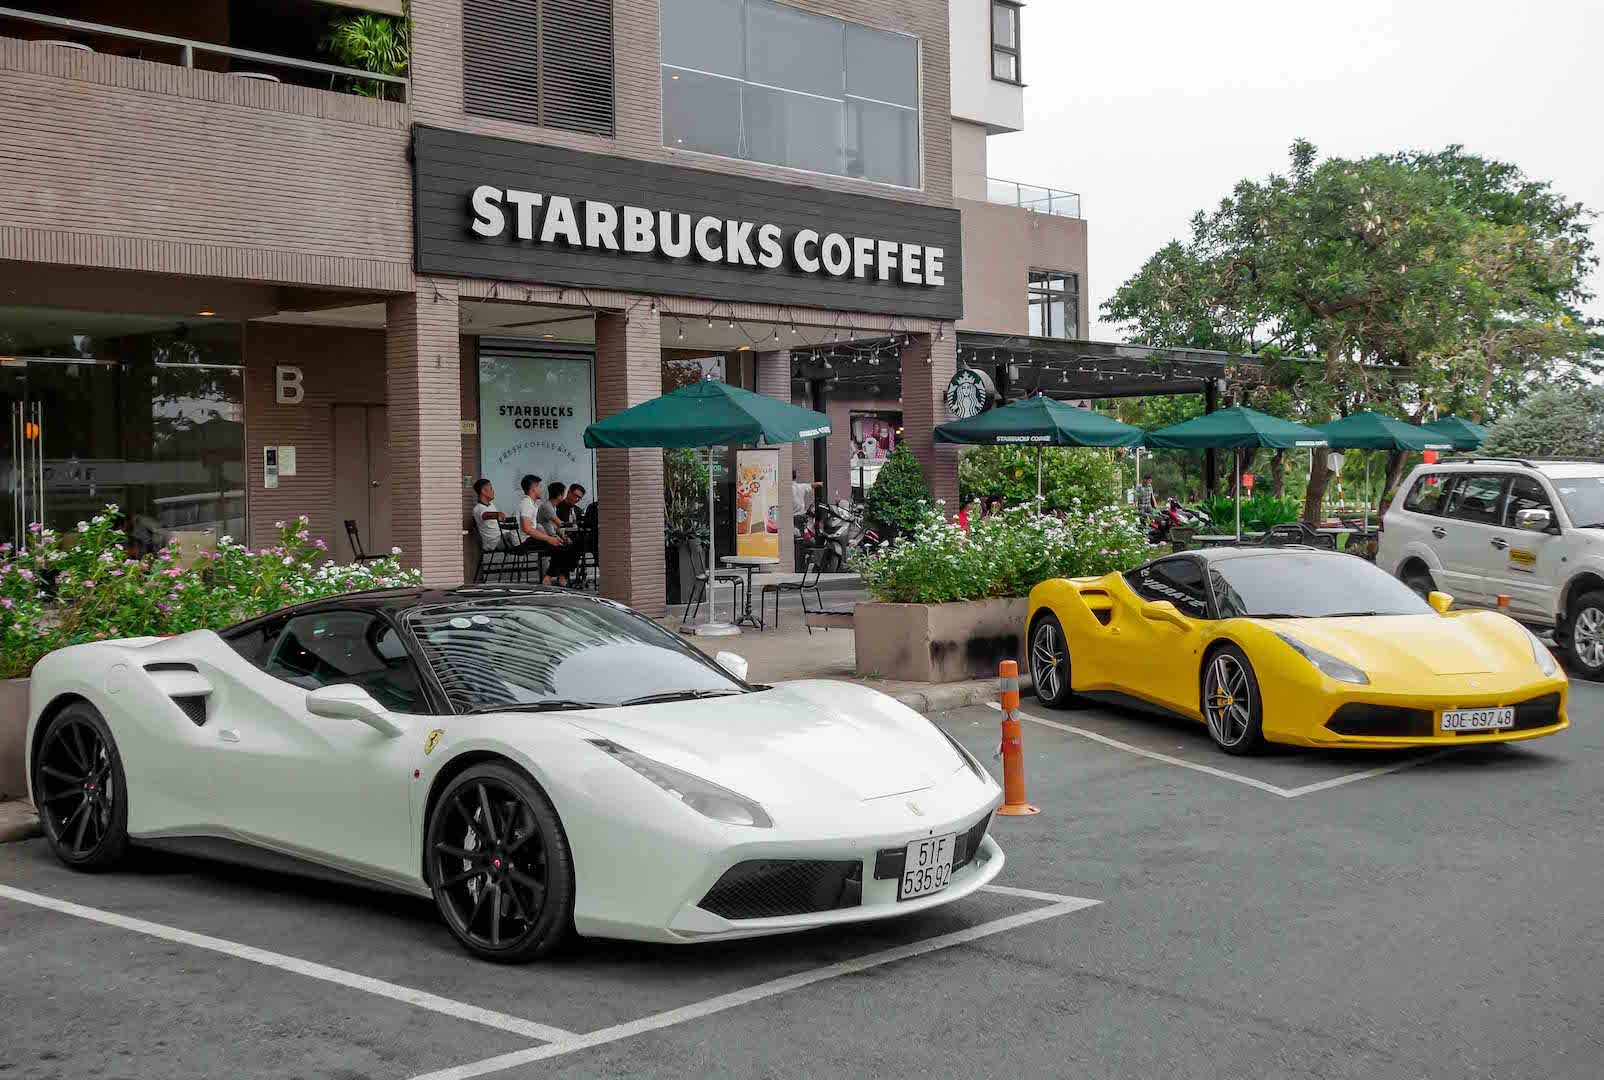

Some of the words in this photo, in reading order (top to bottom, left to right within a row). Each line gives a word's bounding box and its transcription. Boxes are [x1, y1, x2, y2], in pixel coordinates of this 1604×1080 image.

[471, 184, 784, 269] STARBUCKS
[793, 228, 945, 287] COFFEE
[276, 365, 304, 404] B
[499, 405, 574, 417] STARBUCKS
[514, 418, 559, 430] COFFEE
[498, 444, 522, 463] FRESH
[524, 440, 556, 450] COFFEE
[1443, 710, 1512, 729] 30E-697.48
[918, 838, 946, 866] 51F
[904, 862, 951, 895] 535.92
